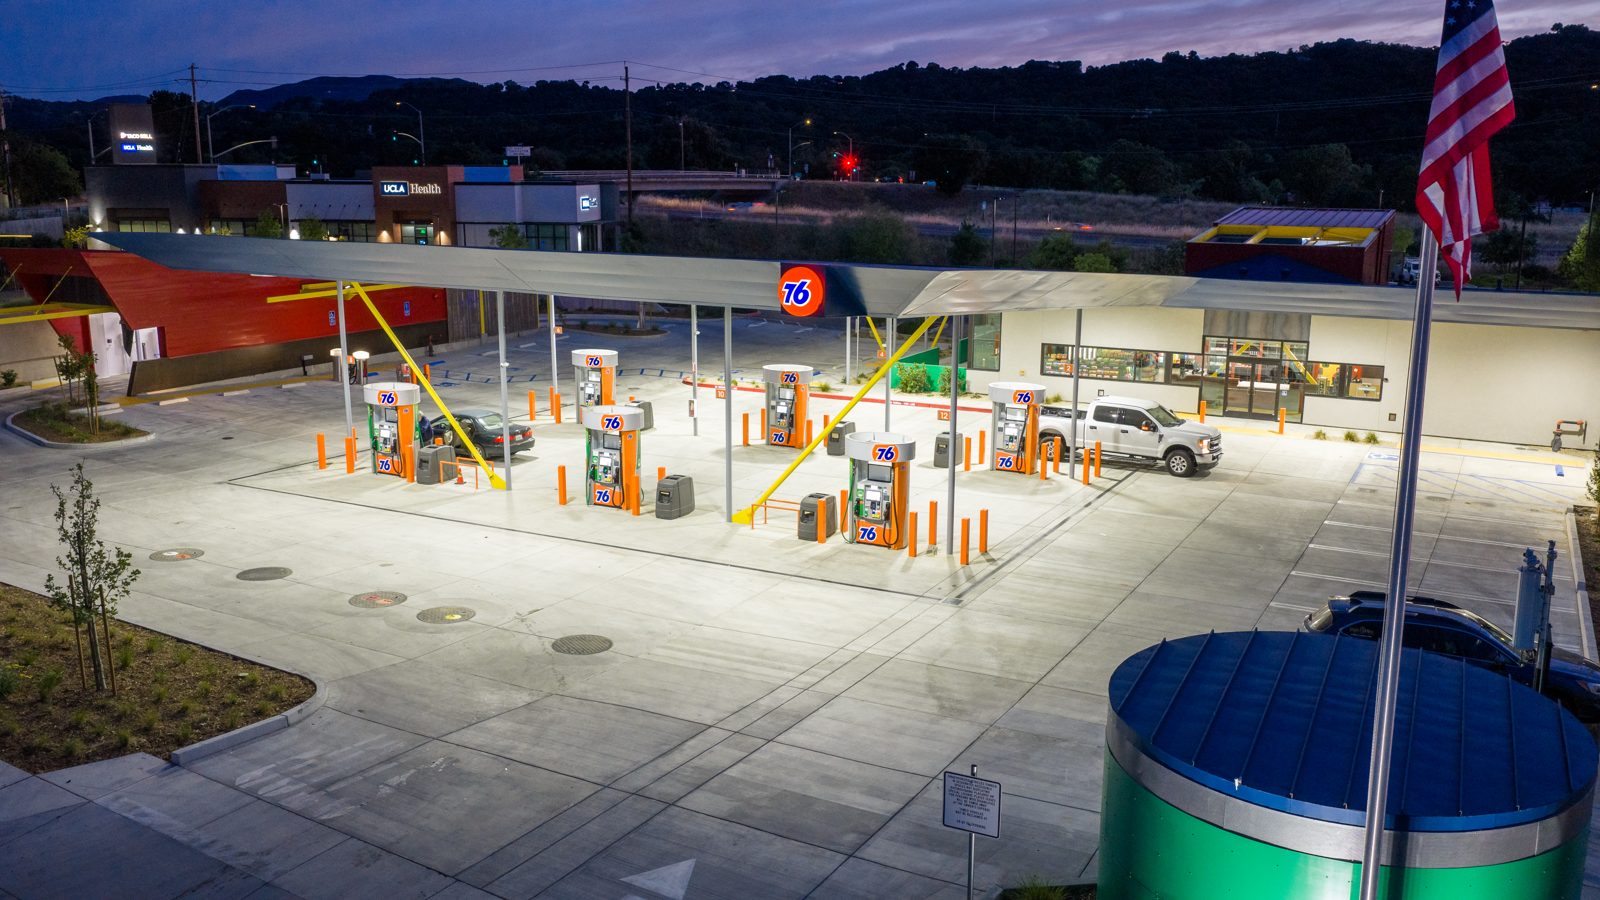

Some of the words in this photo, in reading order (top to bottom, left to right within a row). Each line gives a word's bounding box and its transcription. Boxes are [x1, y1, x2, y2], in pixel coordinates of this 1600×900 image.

[383, 184, 405, 193] UCLA
[410, 183, 441, 194] Health
[782, 279, 811, 306] 76
[588, 356, 601, 367] 76
[784, 373, 797, 384] 76
[380, 392, 395, 405] 76
[717, 390, 725, 398] 10
[1016, 391, 1032, 404] 76
[939, 411, 949, 420] 12
[604, 416, 622, 431] 76
[772, 432, 786, 444] 76
[876, 446, 896, 462] 76
[379, 459, 392, 472] 76
[998, 456, 1014, 469] 76
[595, 489, 611, 504] 76
[859, 526, 878, 542] 76
